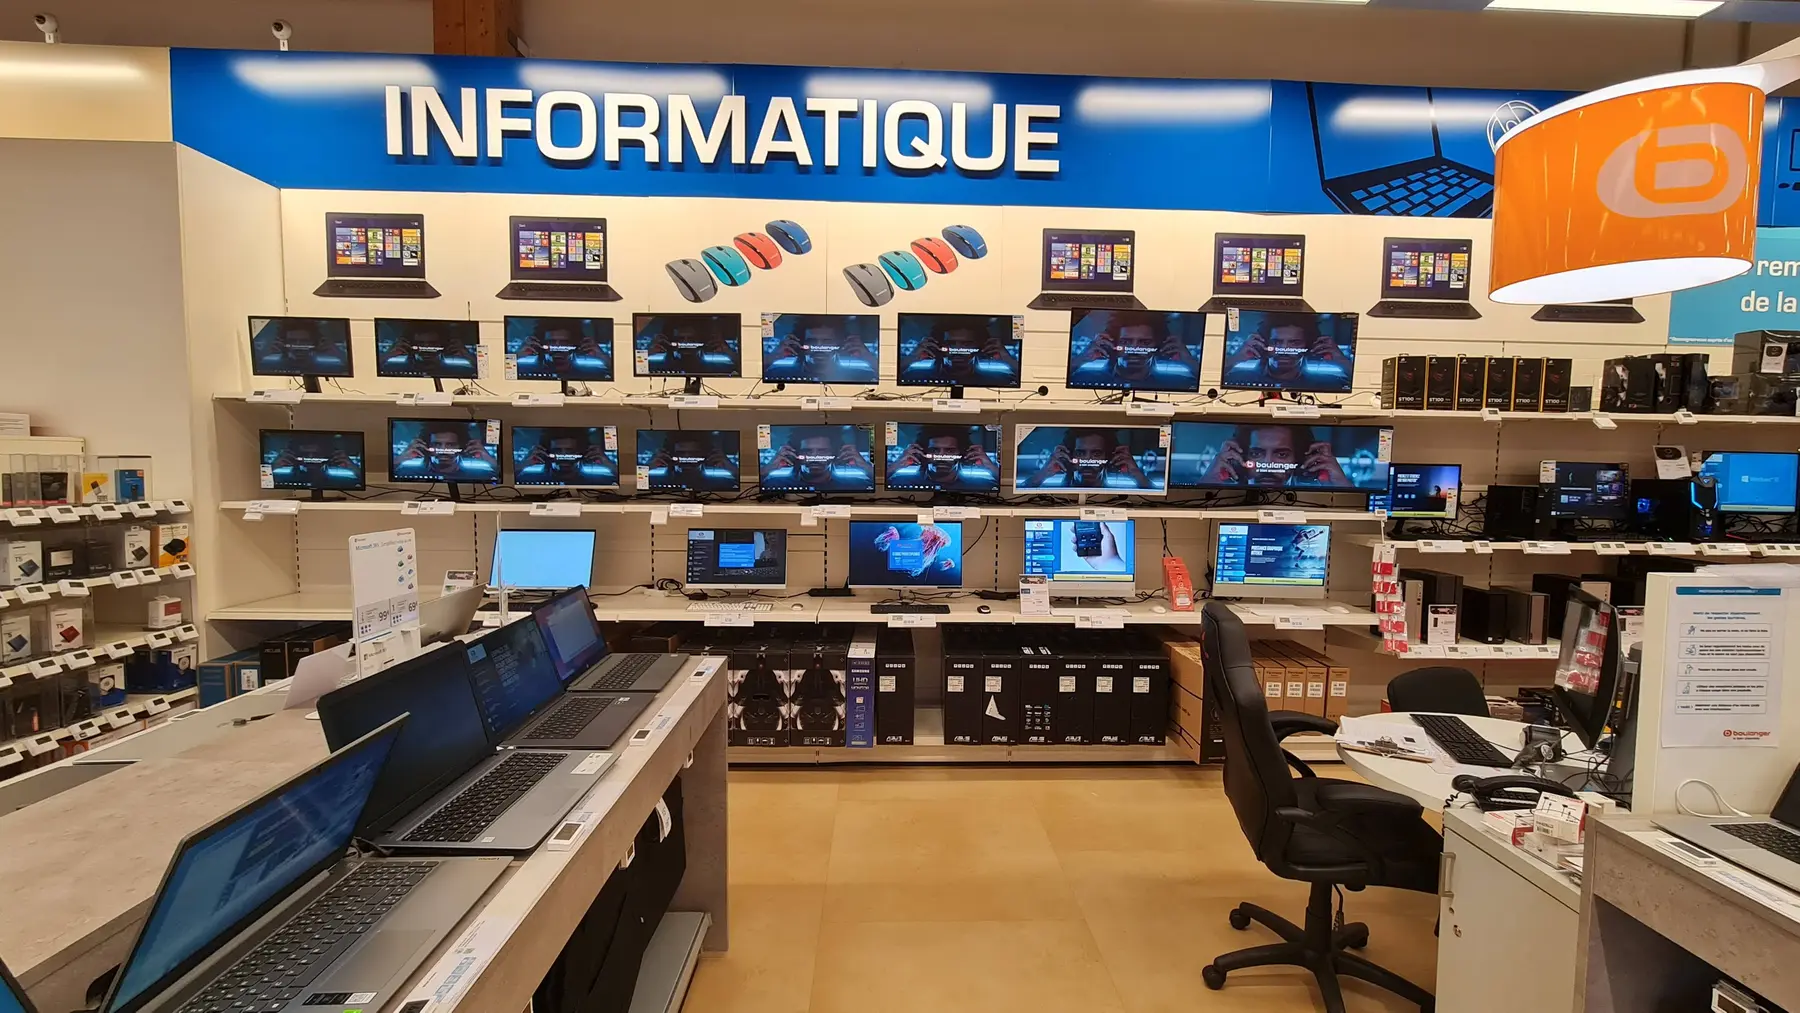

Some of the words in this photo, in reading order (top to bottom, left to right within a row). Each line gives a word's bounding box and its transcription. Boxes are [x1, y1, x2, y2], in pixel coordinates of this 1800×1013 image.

[384, 84, 1061, 174] INFORMATIQUE
[1740, 290, 1770, 313] de
[1776, 290, 1798, 313] la
[1255, 461, 1299, 471] boulanger
[1732, 730, 1771, 738] boulanger
